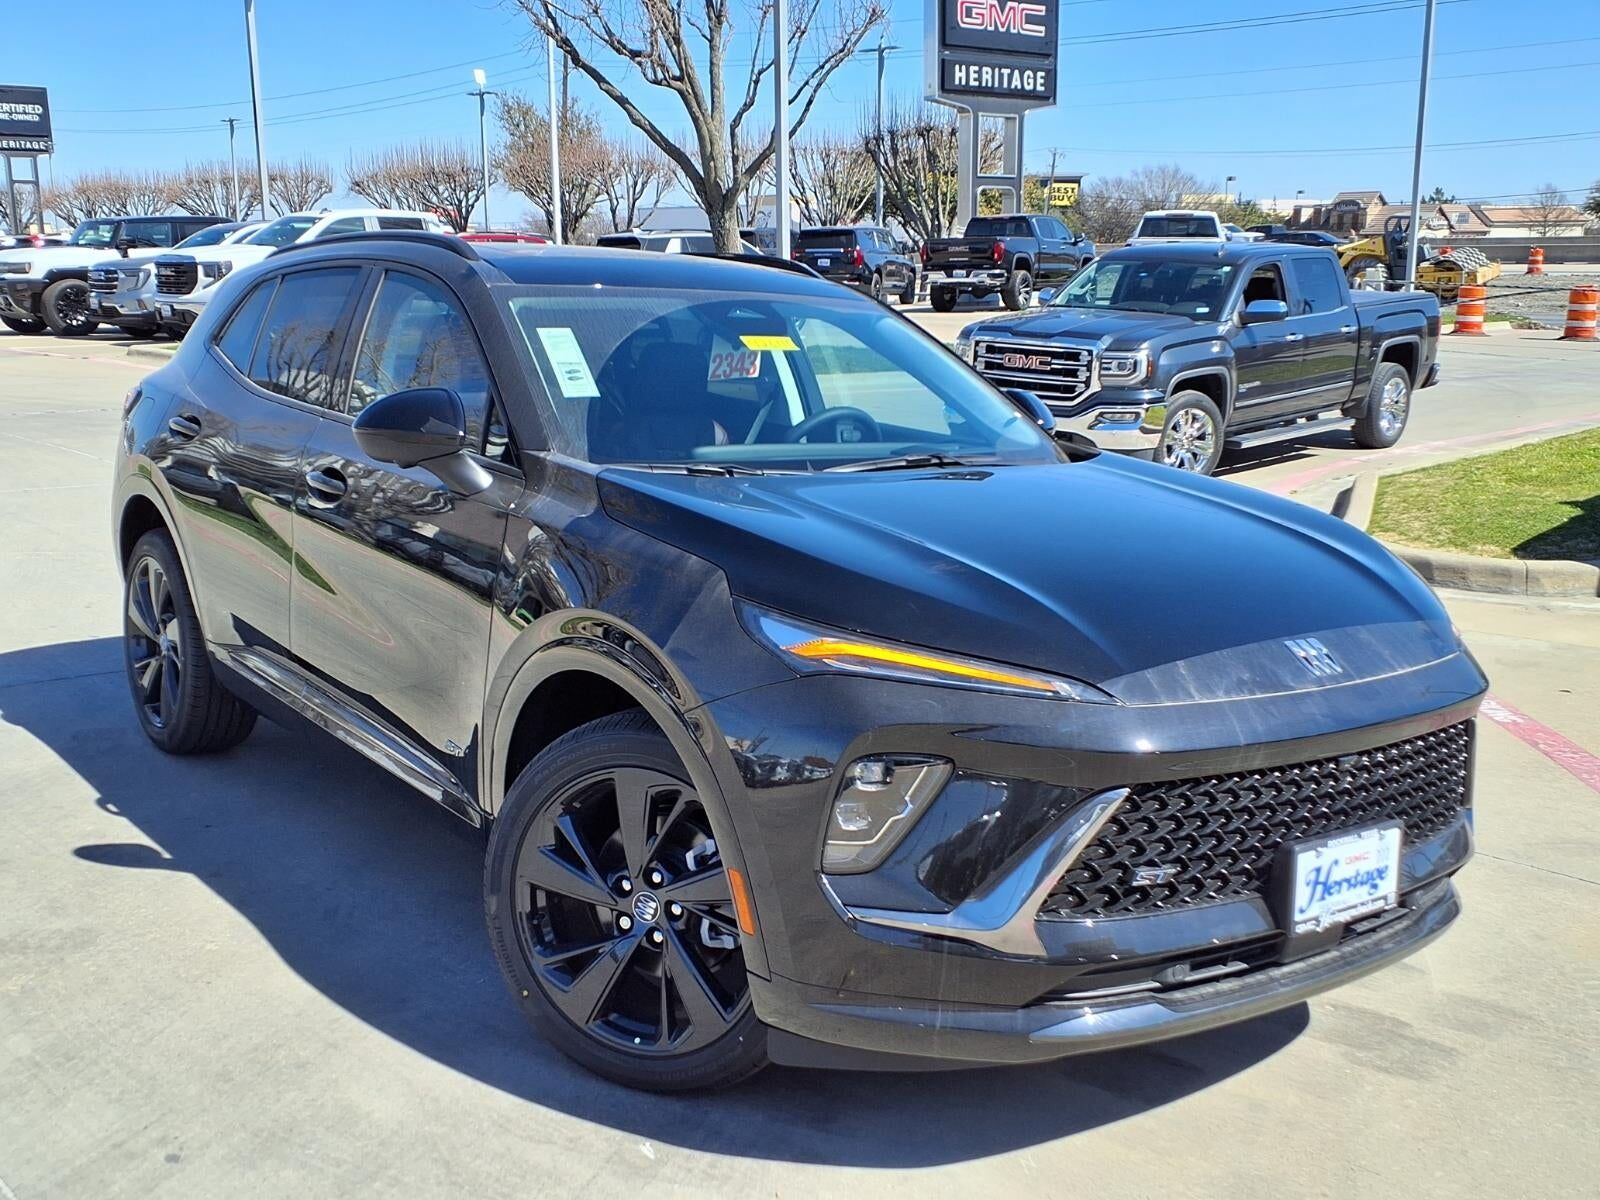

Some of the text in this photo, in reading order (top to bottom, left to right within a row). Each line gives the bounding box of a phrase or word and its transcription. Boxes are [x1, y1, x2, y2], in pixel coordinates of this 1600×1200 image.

[957, 0, 1046, 37] GMC
[954, 64, 1046, 92] HERITAGE
[0, 140, 48, 150] ERITAGE
[1050, 186, 1076, 194] BEST
[1051, 194, 1074, 202] BUY
[710, 351, 758, 379] 2343
[1003, 353, 1051, 370] GMC
[1299, 858, 1390, 915] Heritage
